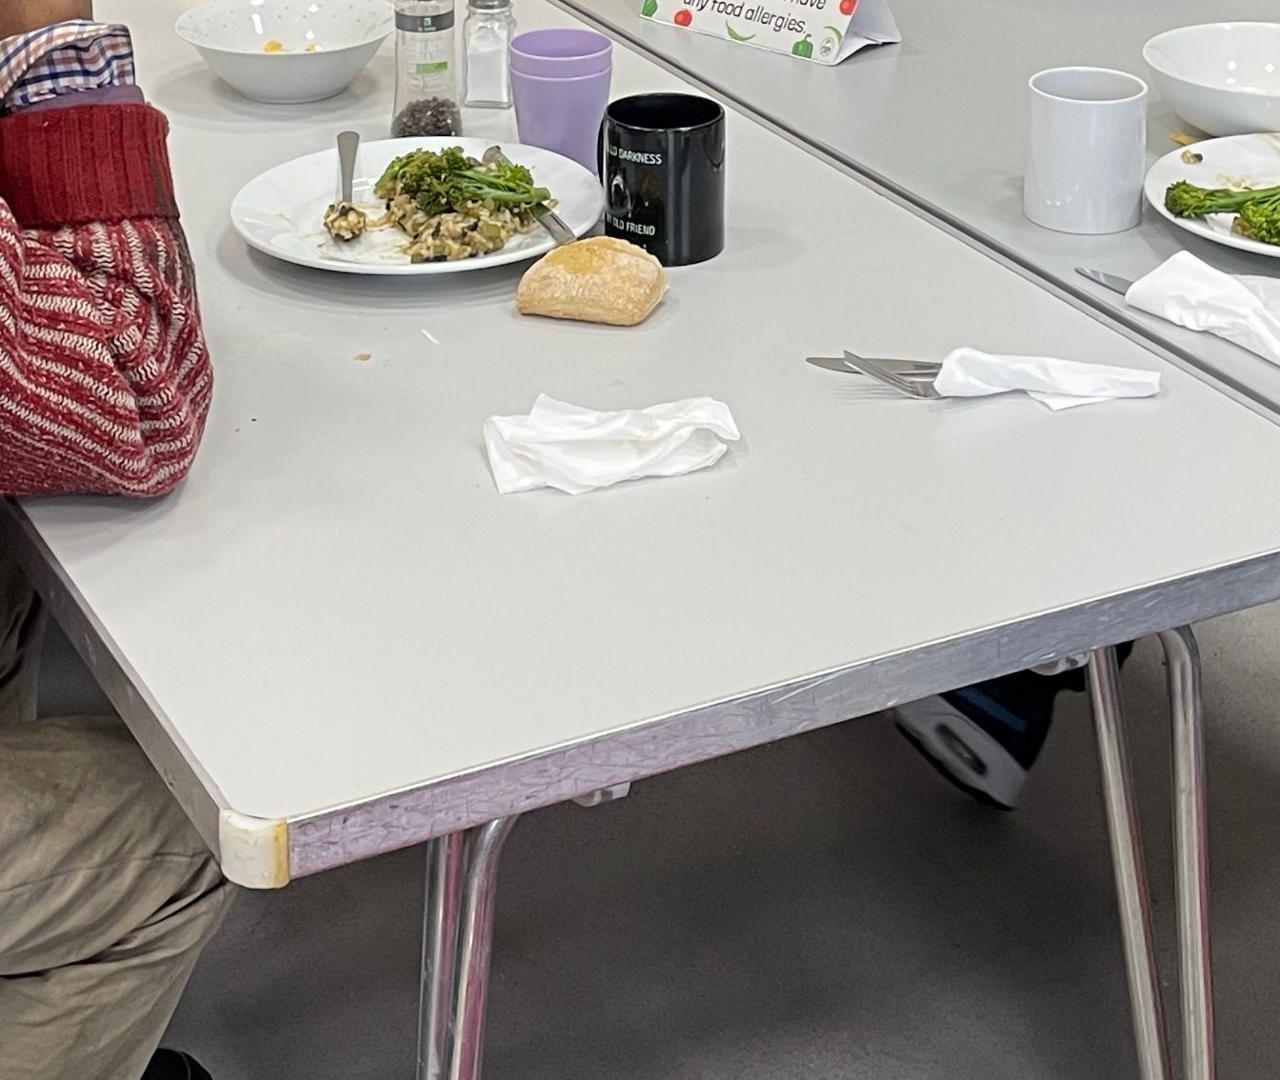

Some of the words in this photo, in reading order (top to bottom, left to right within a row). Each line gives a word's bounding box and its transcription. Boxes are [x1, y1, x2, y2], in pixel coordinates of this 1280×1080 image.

[744, 5, 808, 35] allergies.
[618, 148, 663, 165] DARKNESS
[612, 218, 625, 231] OLD
[626, 221, 656, 236] FRIEND
